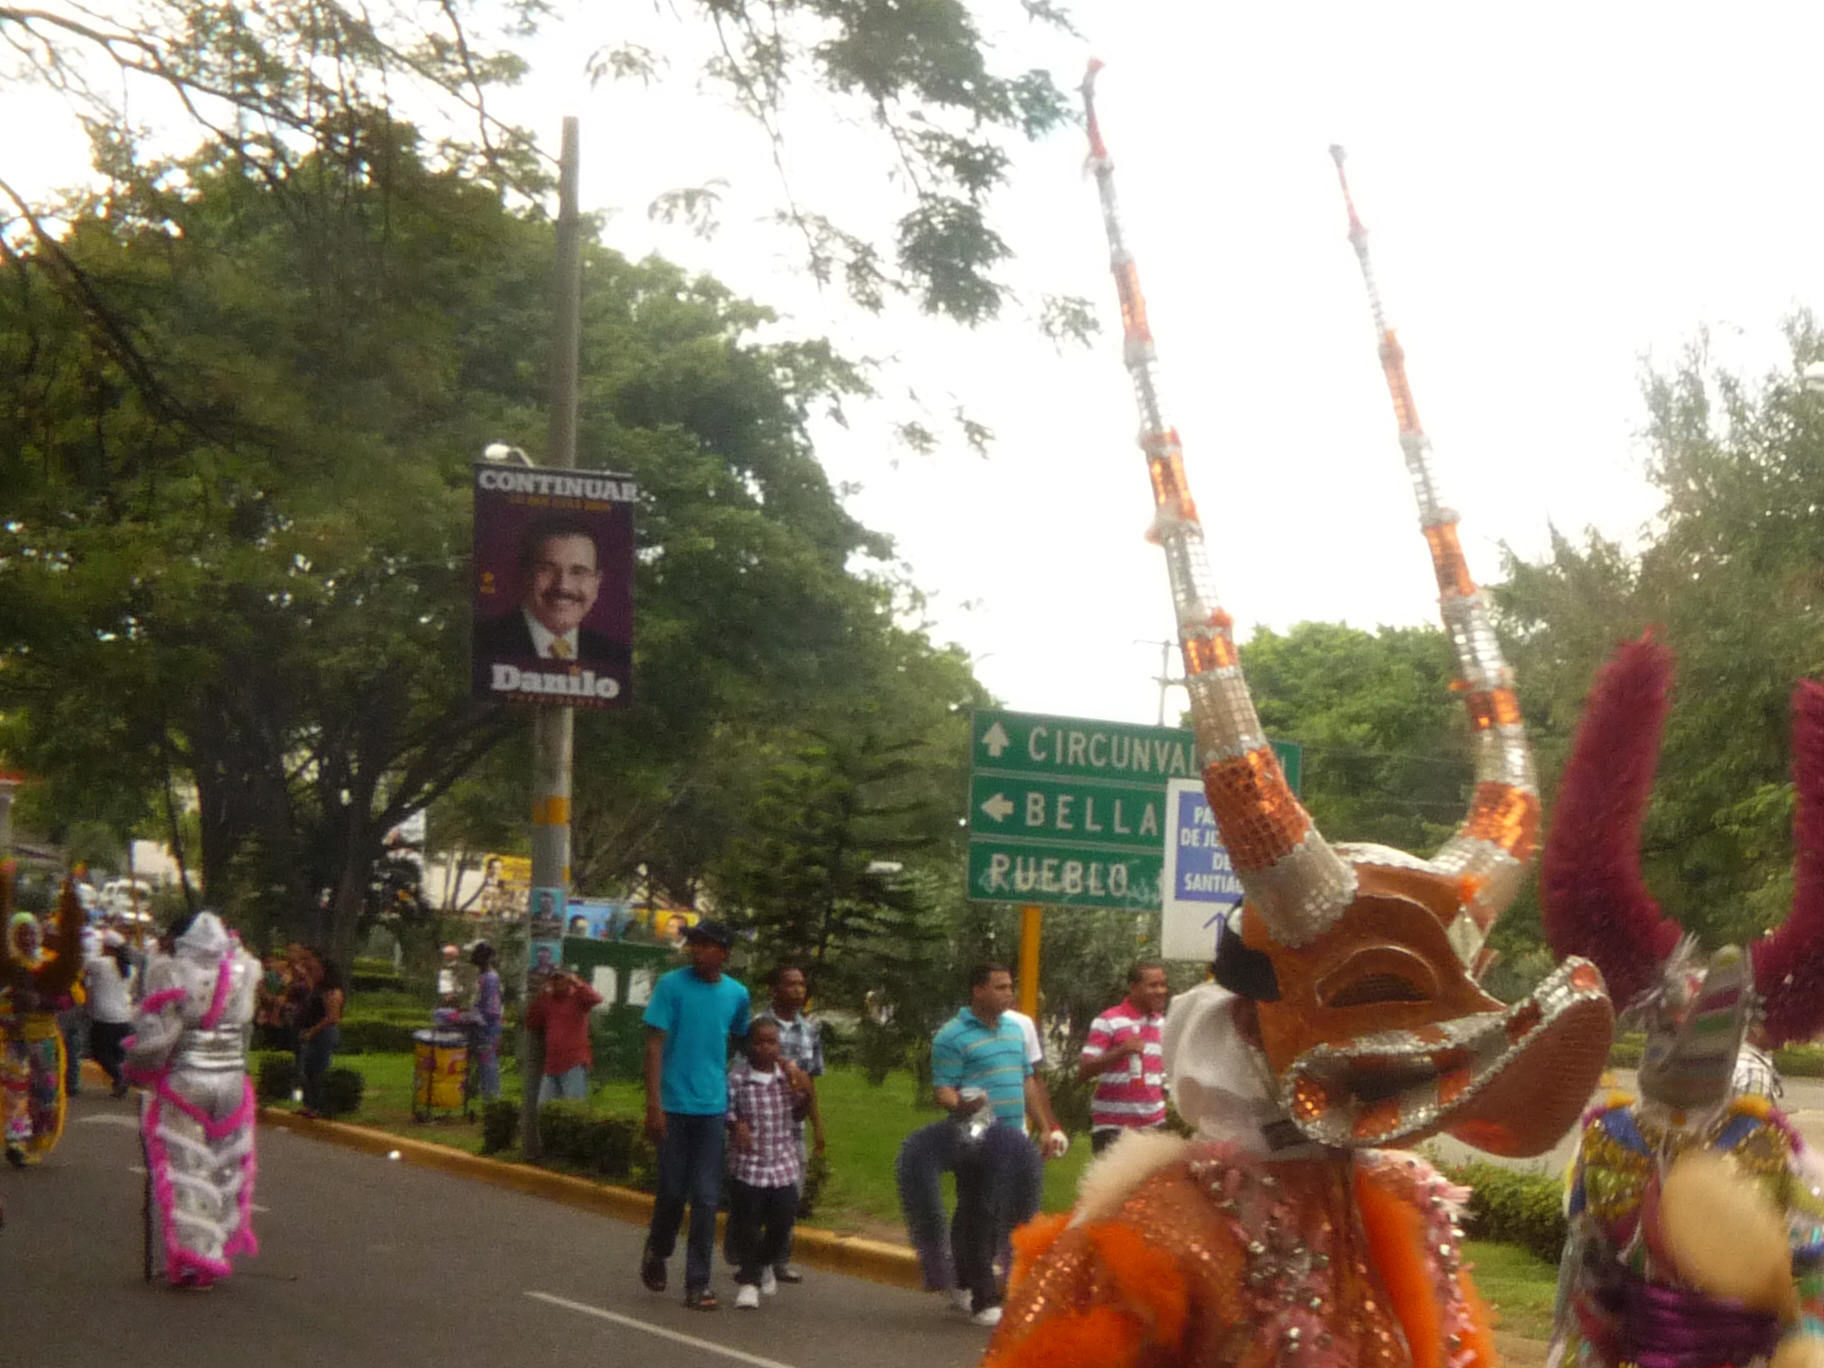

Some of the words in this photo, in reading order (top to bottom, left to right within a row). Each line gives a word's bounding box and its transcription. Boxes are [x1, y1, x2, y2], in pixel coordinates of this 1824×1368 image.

[478, 469, 640, 502] CONTINUAR
[490, 663, 620, 698] Danilo
[1027, 725, 1206, 778] CIRCUNVAL
[1025, 791, 1159, 837] BELLA
[1193, 805, 1217, 825] PA
[1180, 827, 1200, 848] DE
[1203, 829, 1221, 849] JE
[989, 852, 1129, 898] PUEBLO
